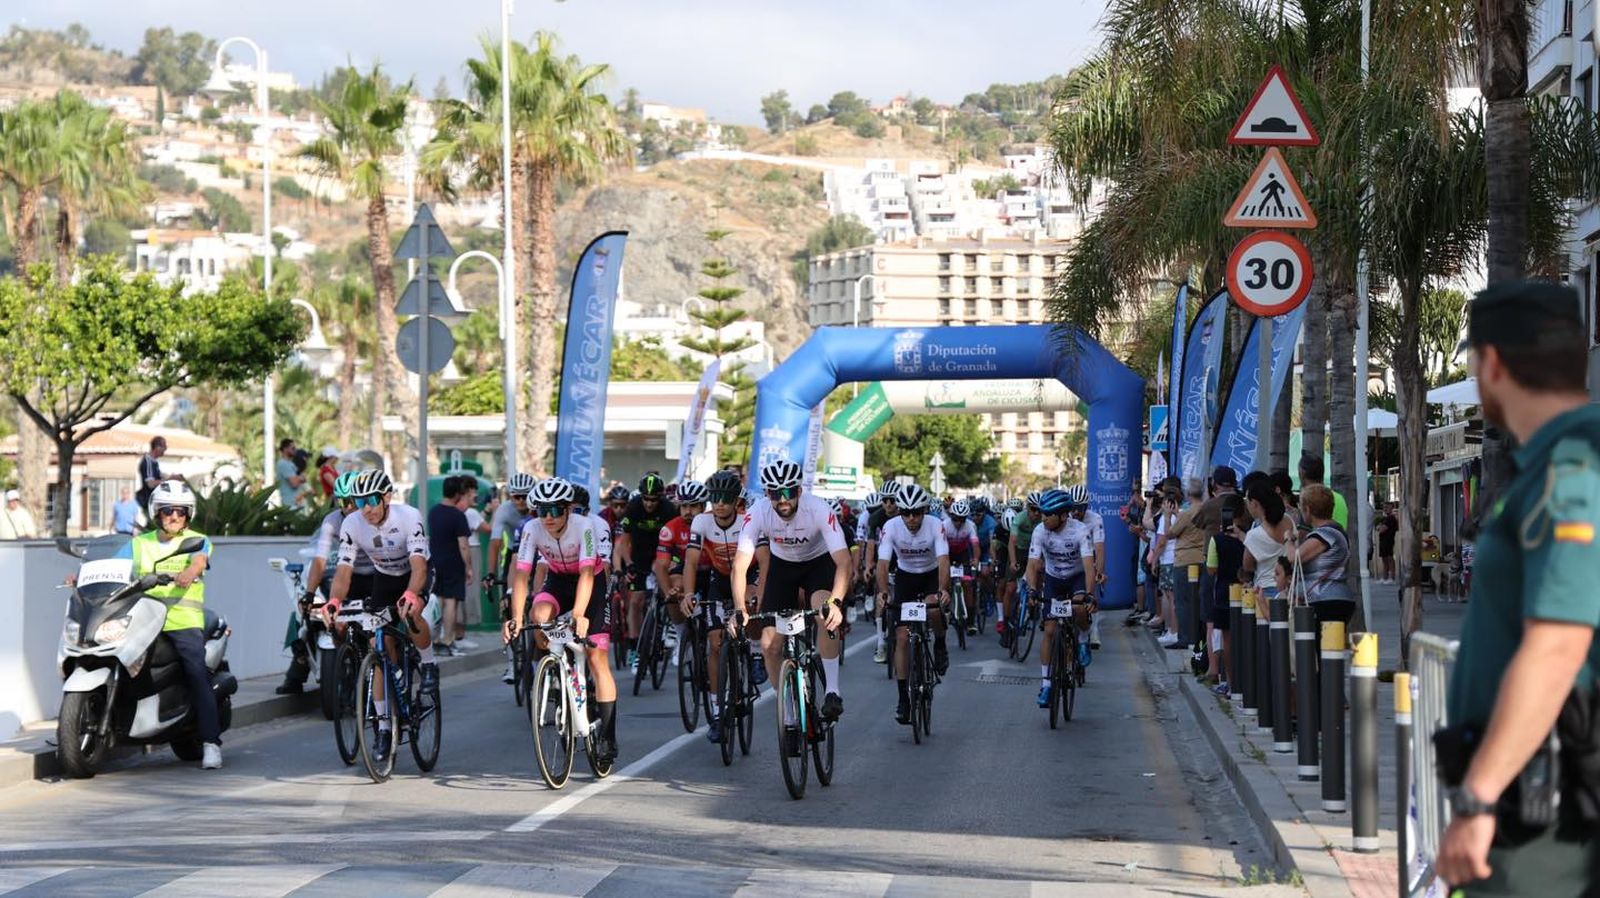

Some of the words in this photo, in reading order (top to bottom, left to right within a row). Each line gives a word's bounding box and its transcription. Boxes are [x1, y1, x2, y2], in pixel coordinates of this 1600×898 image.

[1244, 257, 1294, 290] 30
[928, 343, 996, 359] Diputación
[928, 361, 941, 372] de
[945, 360, 997, 372] Granada
[567, 293, 607, 490] LMUÑÉCAR
[82, 572, 124, 583] PRENSA
[908, 609, 919, 617] 88
[1055, 606, 1068, 615] 129
[788, 622, 794, 631] 3
